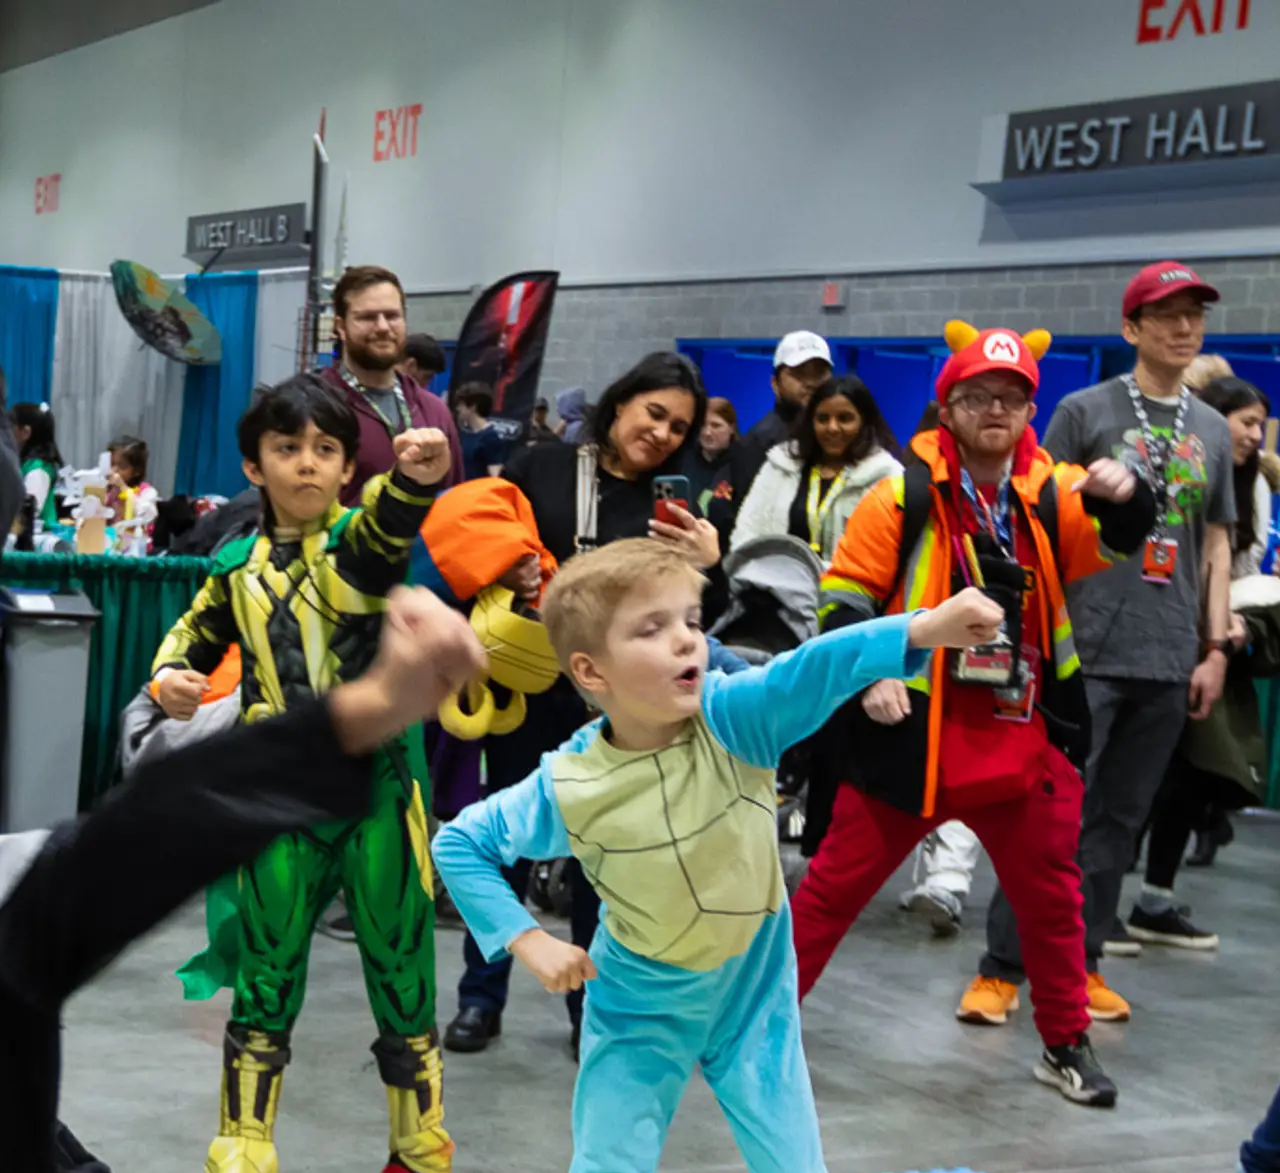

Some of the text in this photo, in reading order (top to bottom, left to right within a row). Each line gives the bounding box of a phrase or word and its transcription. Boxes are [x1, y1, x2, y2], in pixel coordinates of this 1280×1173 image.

[373, 104, 423, 162] EXIT
[1014, 116, 1132, 171] WEST
[1144, 102, 1266, 160] HALL
[34, 173, 62, 215] EXIT
[195, 214, 289, 249] WEST HALL B
[990, 340, 1015, 357] M
